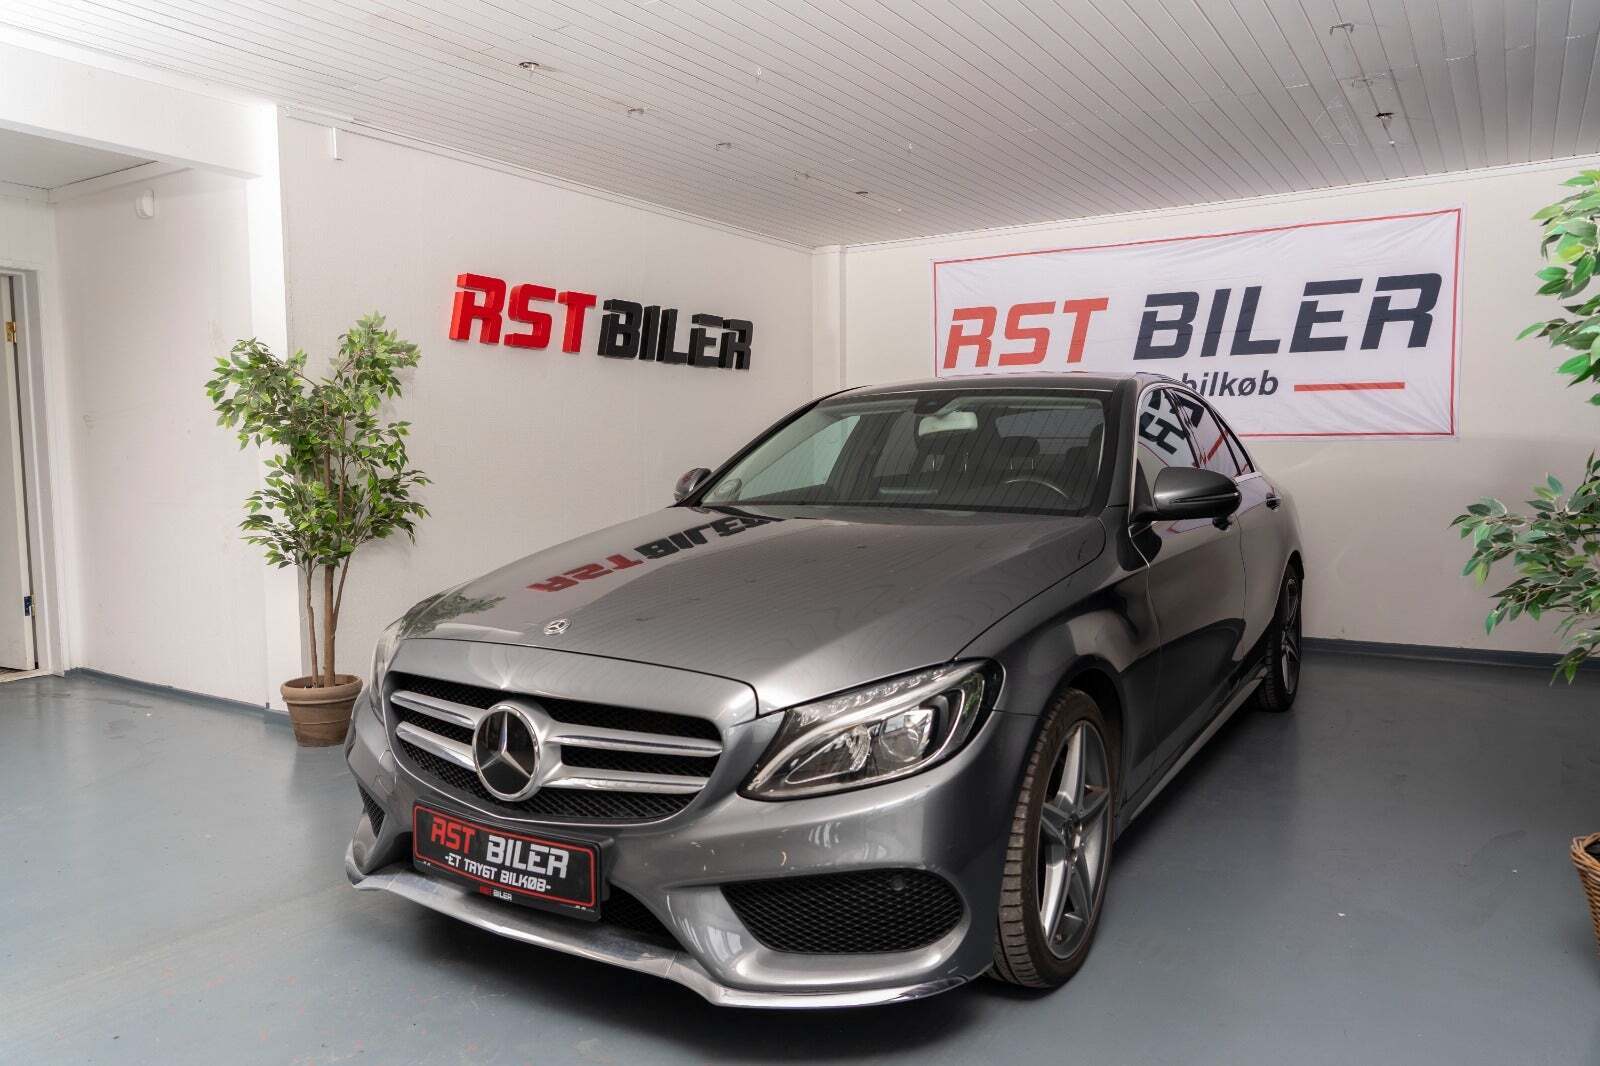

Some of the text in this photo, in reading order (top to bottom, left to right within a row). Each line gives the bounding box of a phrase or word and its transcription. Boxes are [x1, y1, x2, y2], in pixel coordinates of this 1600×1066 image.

[449, 272, 754, 370] RST BILER
[943, 272, 1442, 369] RST BILER
[430, 816, 570, 879] RST BILER
[463, 857, 499, 880] TRYGT
